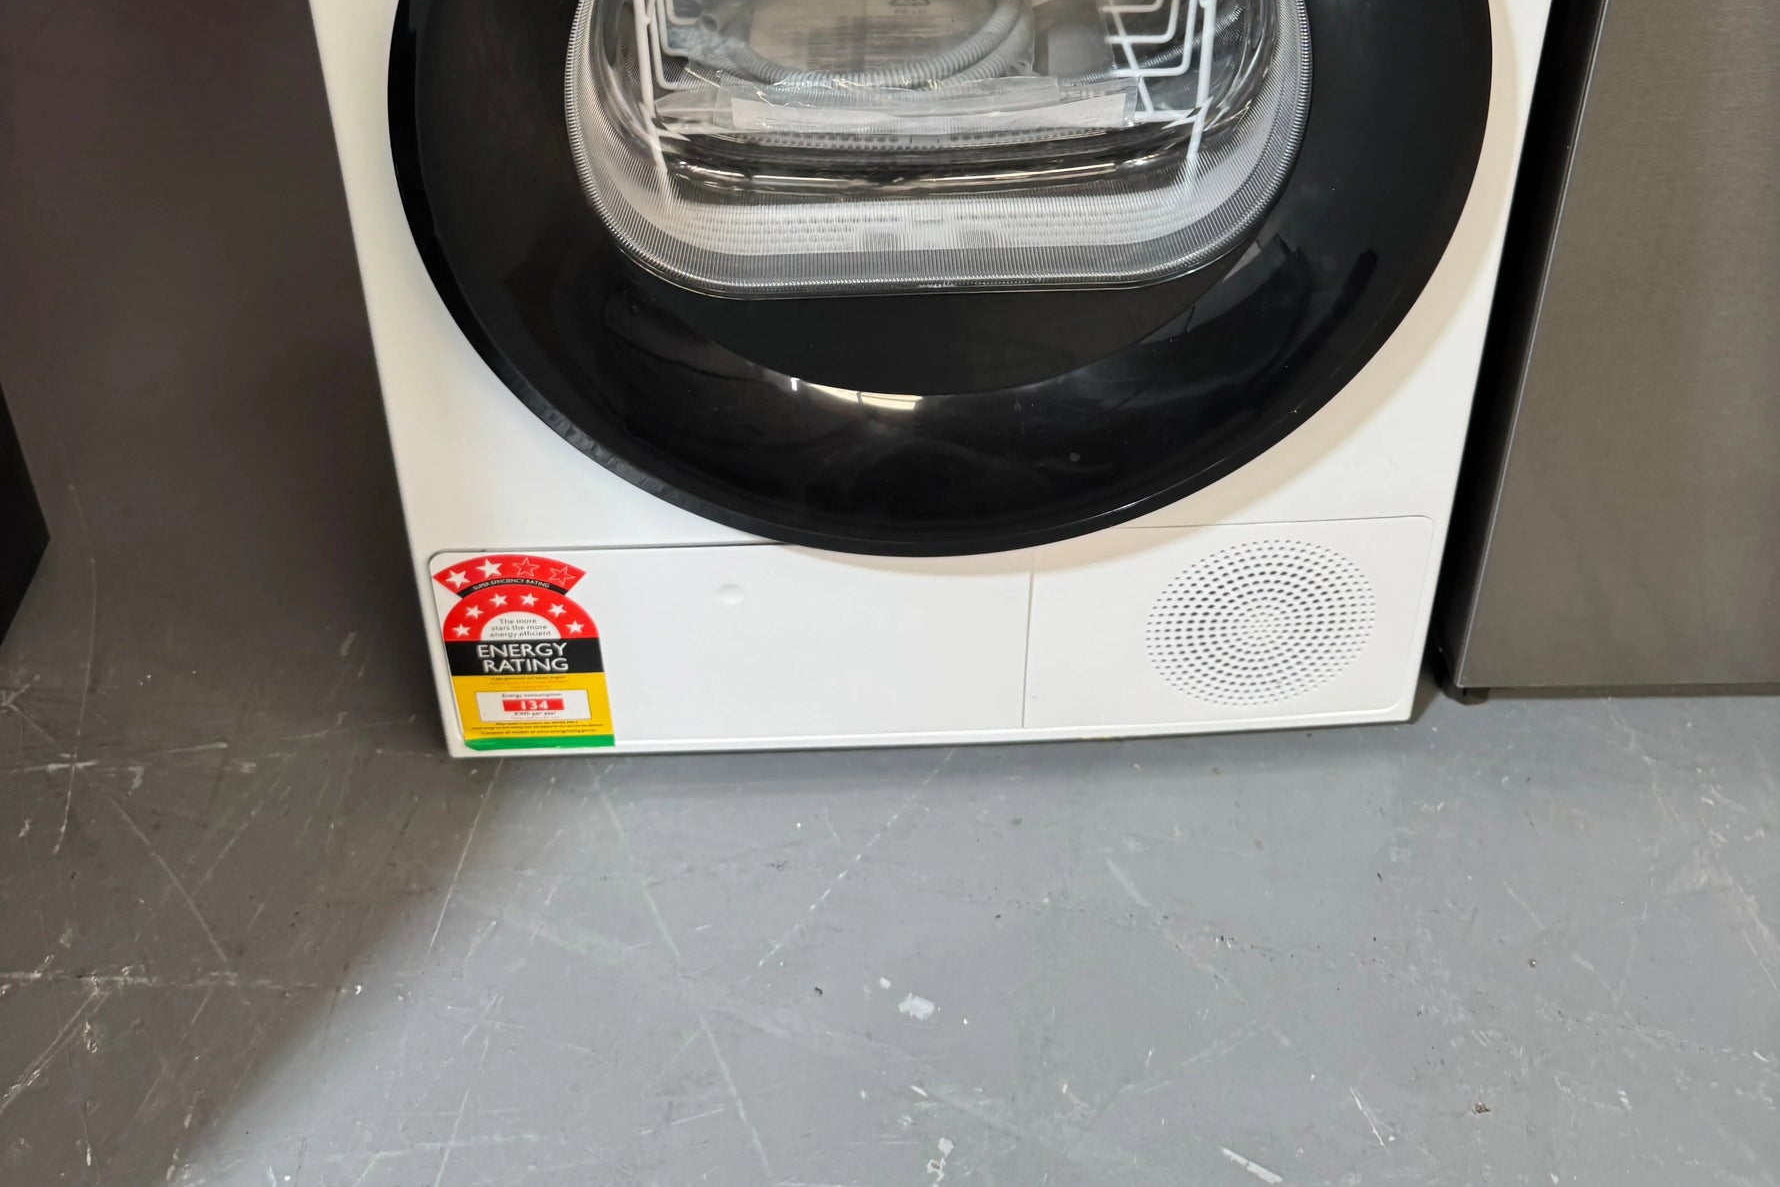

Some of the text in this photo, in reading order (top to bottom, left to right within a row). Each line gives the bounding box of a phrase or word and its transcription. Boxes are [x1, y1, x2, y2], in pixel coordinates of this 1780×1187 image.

[525, 579, 550, 588] RATING
[477, 642, 568, 658] ENERGY
[483, 657, 569, 673] RATING
[521, 700, 549, 710] 134
